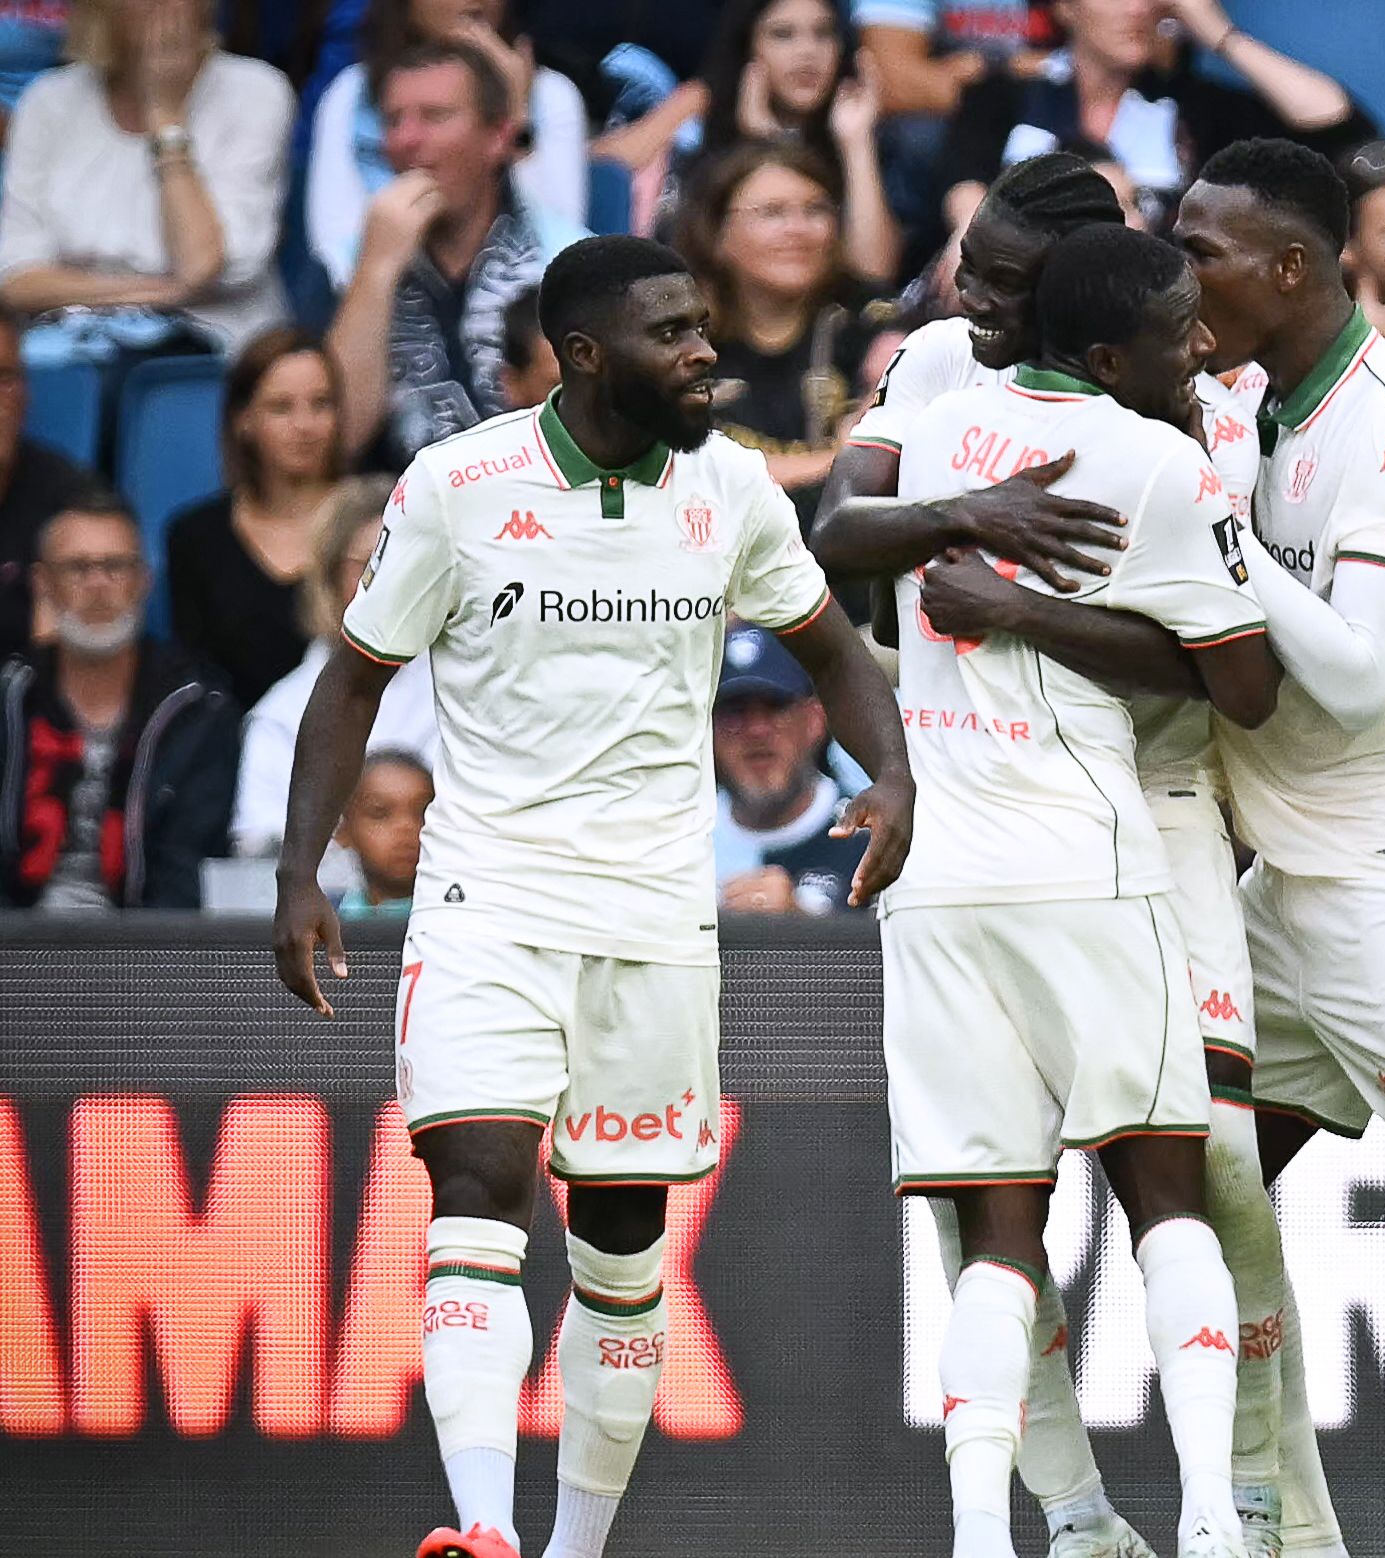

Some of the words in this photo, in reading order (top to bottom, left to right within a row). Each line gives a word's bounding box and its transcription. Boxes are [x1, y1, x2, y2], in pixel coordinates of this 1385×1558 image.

[448, 446, 532, 488] actual
[401, 961, 424, 1045] 7
[565, 1104, 684, 1142] vbet
[0, 1092, 746, 1442] MAX
[599, 1332, 664, 1352] OGC
